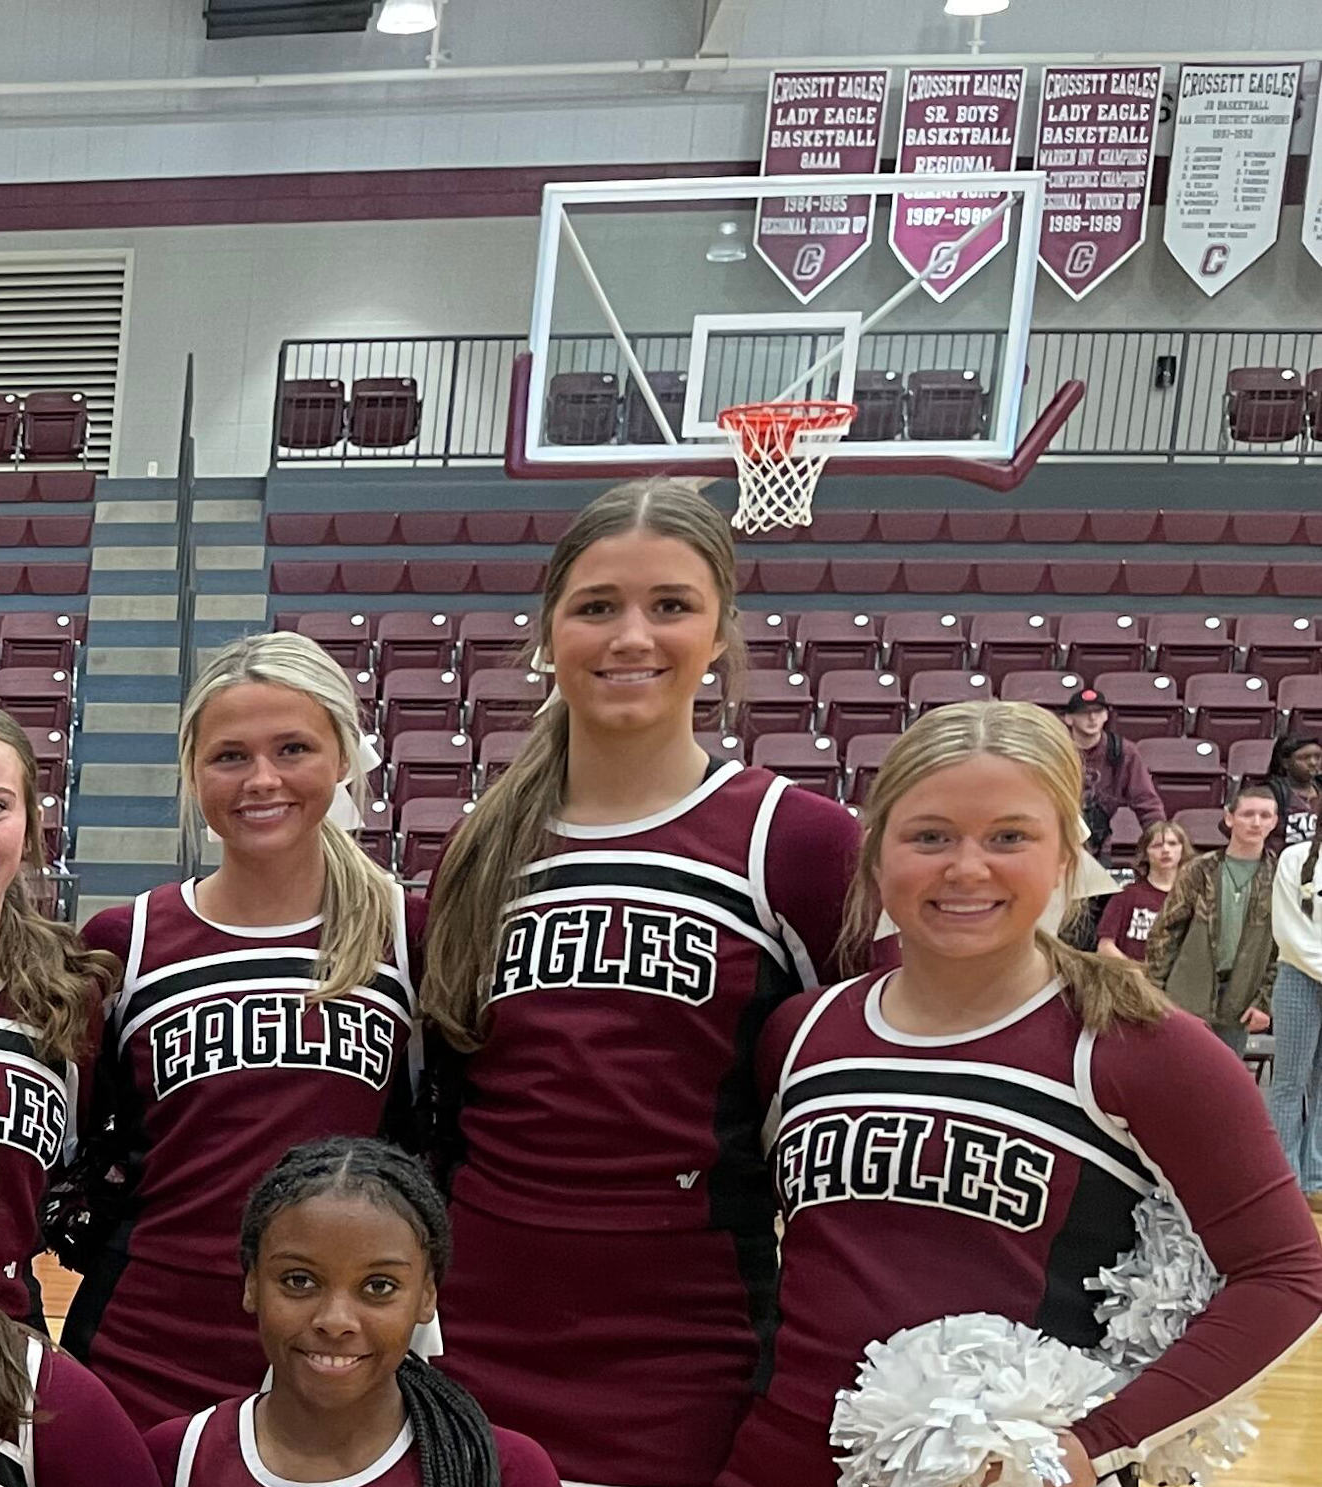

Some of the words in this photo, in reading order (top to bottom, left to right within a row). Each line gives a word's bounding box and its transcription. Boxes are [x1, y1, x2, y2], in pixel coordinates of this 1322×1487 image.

[774, 77, 835, 104] CROSSETT
[837, 76, 884, 103] EAGLES
[908, 75, 971, 102] CROSSETT
[973, 74, 1020, 101] EAGLES
[1045, 74, 1108, 100] CROSSETT
[1110, 72, 1158, 99] EAGLES
[1181, 73, 1245, 98] CROSSETT
[1249, 72, 1296, 98] EAGLES
[776, 108, 819, 125] LADY
[824, 107, 877, 125] EAGLE
[925, 105, 950, 123] SR.
[956, 105, 999, 123] BOYS
[1047, 104, 1092, 122] LADY
[1097, 103, 1151, 121] EAGLE
[771, 129, 876, 148] BASKETBALL
[905, 127, 1012, 146] BASKETBALL
[1042, 126, 1149, 144] BASKETBALL
[914, 156, 995, 173] REGIONAL
[1049, 215, 1122, 232] 1988-1989
[488, 905, 717, 1007] AGLES
[150, 993, 394, 1101] EAGLES
[776, 1111, 1055, 1233] EAGLES
